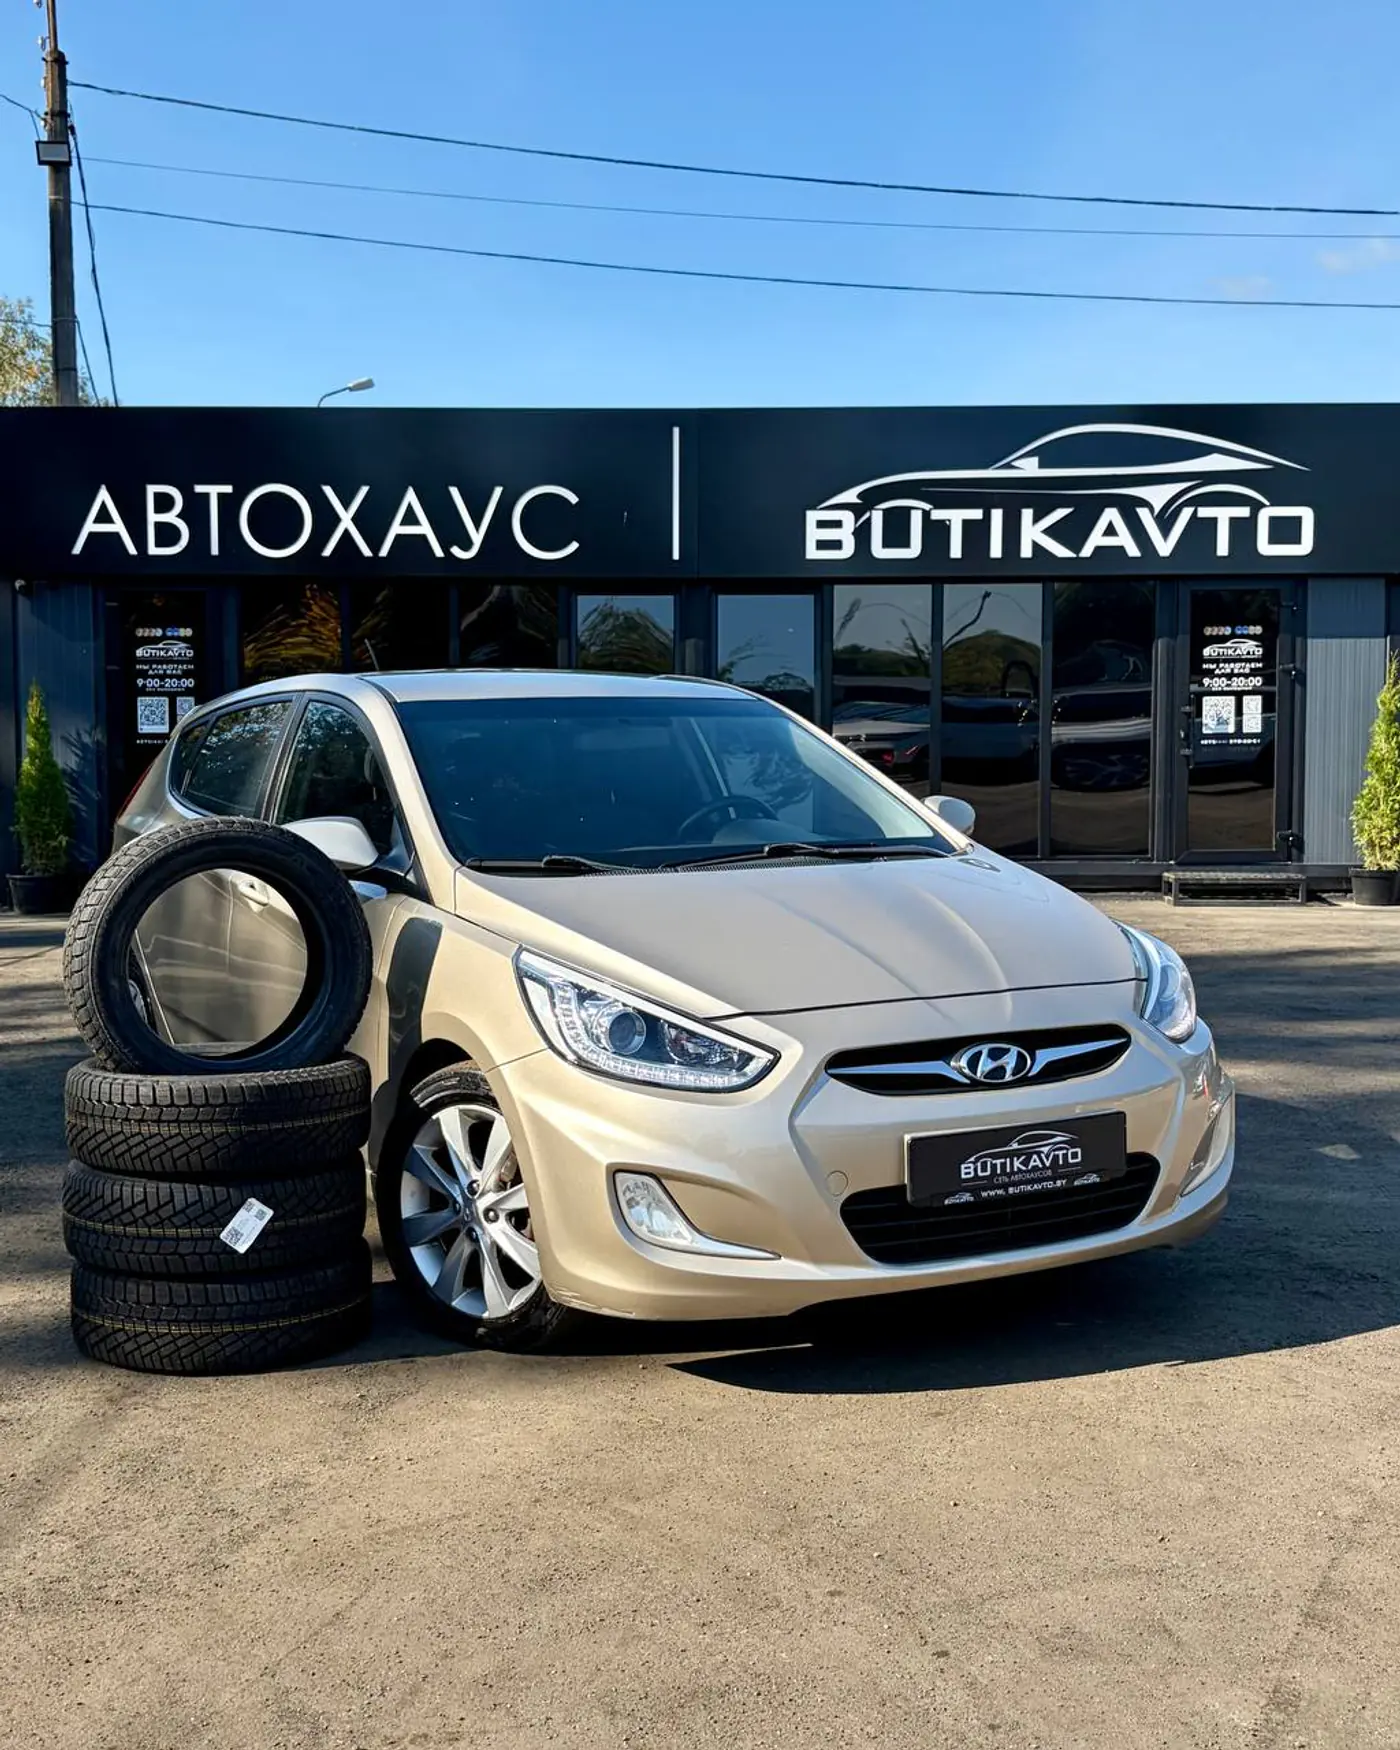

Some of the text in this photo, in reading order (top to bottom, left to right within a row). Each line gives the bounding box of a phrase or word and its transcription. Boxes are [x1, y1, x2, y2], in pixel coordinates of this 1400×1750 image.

[71, 483, 579, 560] АВТОХАУС
[804, 505, 1315, 560] BUTIKAVTO
[136, 649, 194, 657] BUTIKAVTO
[1203, 648, 1263, 656] BUTIKAVTO
[137, 678, 195, 687] 9:00-20:00
[1203, 677, 1263, 687] 9:00-20:00
[961, 1148, 1082, 1179] BUTIKAVTO
